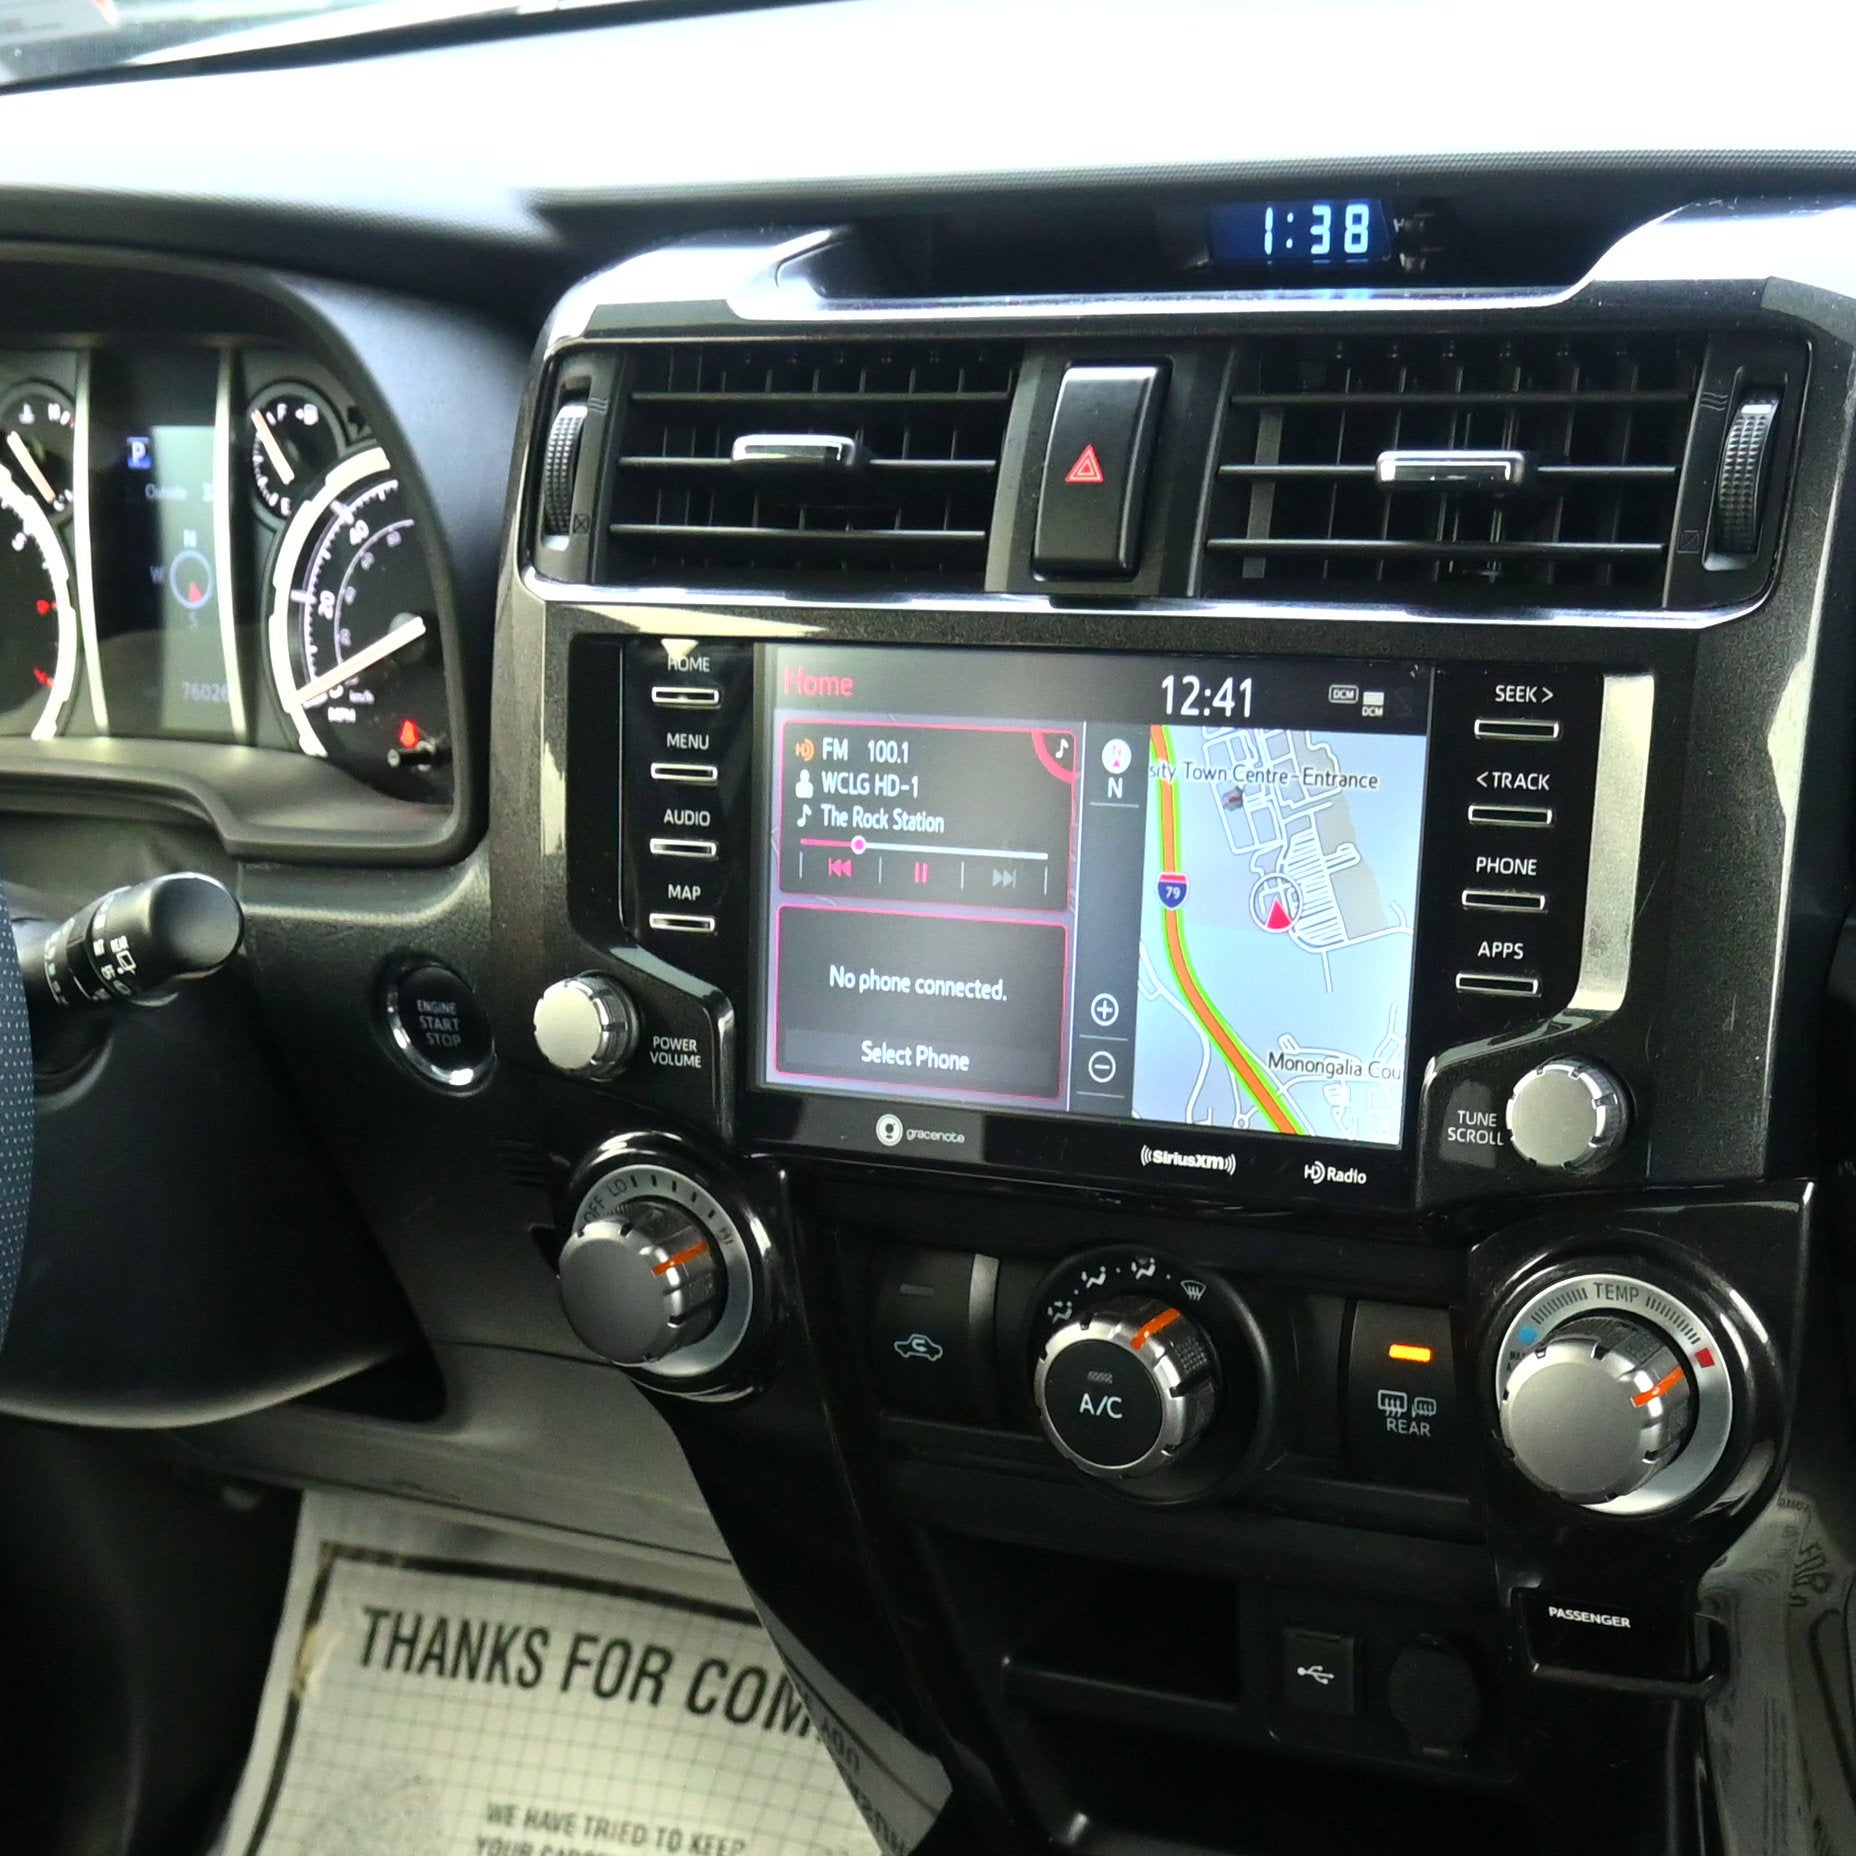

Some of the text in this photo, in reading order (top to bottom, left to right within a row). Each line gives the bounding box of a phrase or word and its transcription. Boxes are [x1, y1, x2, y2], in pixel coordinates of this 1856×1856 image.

[1263, 203, 1371, 256] 1:38
[131, 442, 147, 465] P
[666, 655, 712, 673] HOME
[783, 665, 855, 698] Home
[1160, 675, 1253, 719] 12:41
[1331, 687, 1357, 701] DCM
[1494, 684, 1537, 703] SEEK
[1361, 705, 1385, 717] DCM
[666, 732, 710, 750] MENU
[822, 738, 849, 761] FM
[867, 739, 910, 764] 100.1
[821, 770, 920, 798] WCLG HD-1
[1149, 760, 1379, 791] sity Town Centre-Entrance
[1491, 771, 1552, 792] TRACK
[1106, 775, 1124, 800] N
[663, 809, 712, 828] AUDIO
[820, 803, 946, 834] The Rock Station
[1474, 856, 1539, 876] PHONE
[667, 883, 702, 902] MAP
[1165, 885, 1182, 900] 79
[1476, 941, 1525, 961] APPS
[829, 965, 1008, 1003] No phone connected.
[416, 999, 457, 1015] ENGINE
[419, 1015, 460, 1032] START
[425, 1032, 462, 1048] STOP
[652, 1035, 698, 1053] POWER
[649, 1050, 702, 1070] VOLUME
[860, 1040, 971, 1073] Select Phone
[1267, 1050, 1402, 1080] Monongalia Cou
[1456, 1109, 1499, 1128] TUNE
[906, 1127, 966, 1145] gracenote
[1447, 1126, 1505, 1148] SCROLL
[1326, 1166, 1368, 1186] Radio
[605, 1177, 629, 1198] LO
[1592, 1281, 1641, 1304] TEMP
[1078, 1391, 1124, 1420] A/C
[1385, 1417, 1432, 1437] REAR
[1548, 1605, 1632, 1629] PASSENGER
[359, 1606, 820, 1742] THANKS FOR COM
[486, 1801, 517, 1827] WE
[523, 1806, 577, 1837] HAVE
[584, 1814, 648, 1848] TRIED
[655, 1825, 683, 1854] TO
